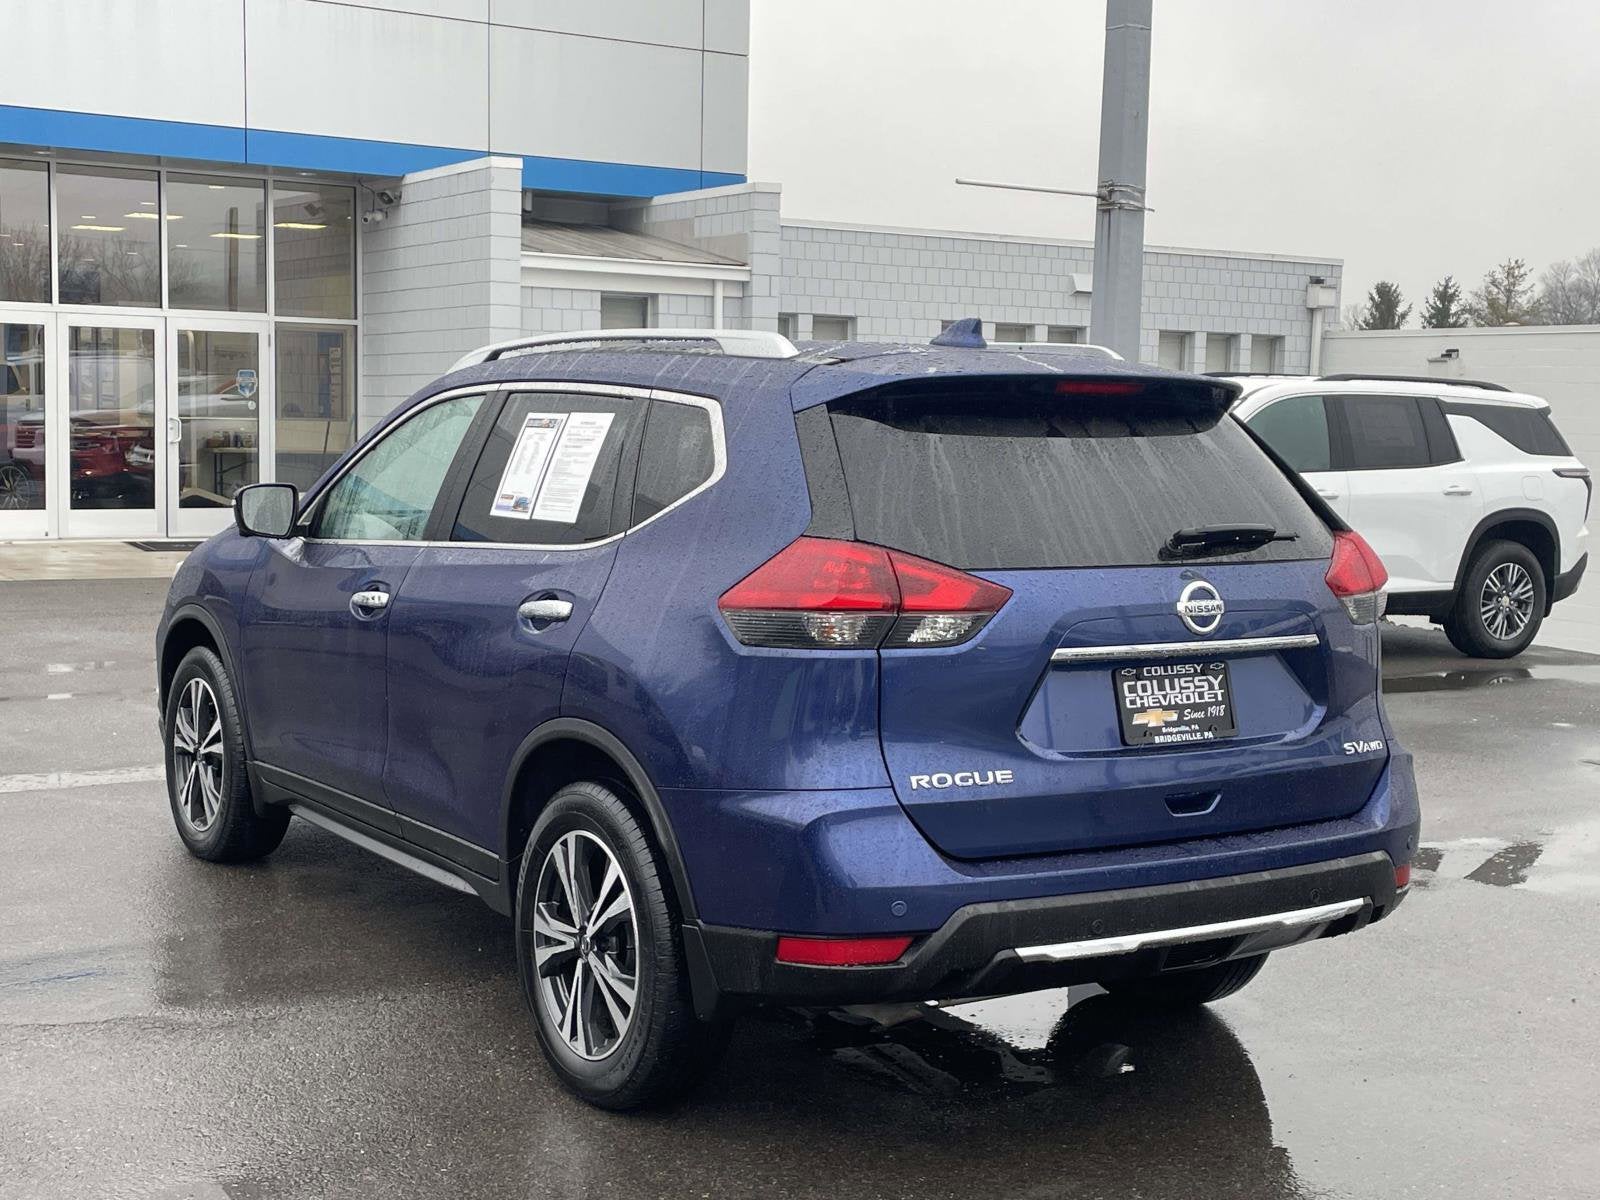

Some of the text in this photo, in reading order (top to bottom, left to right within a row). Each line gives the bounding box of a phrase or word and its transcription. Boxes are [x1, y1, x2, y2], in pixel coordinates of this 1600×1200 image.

[1184, 604, 1222, 613] NISSAN
[1143, 664, 1203, 676] COLUSSY
[1123, 675, 1224, 697] COLUSSY
[1125, 690, 1224, 708] CHEVROLET
[1183, 705, 1225, 720] Since 1918
[1203, 731, 1213, 739] PA
[909, 769, 1014, 790] ROGUE
